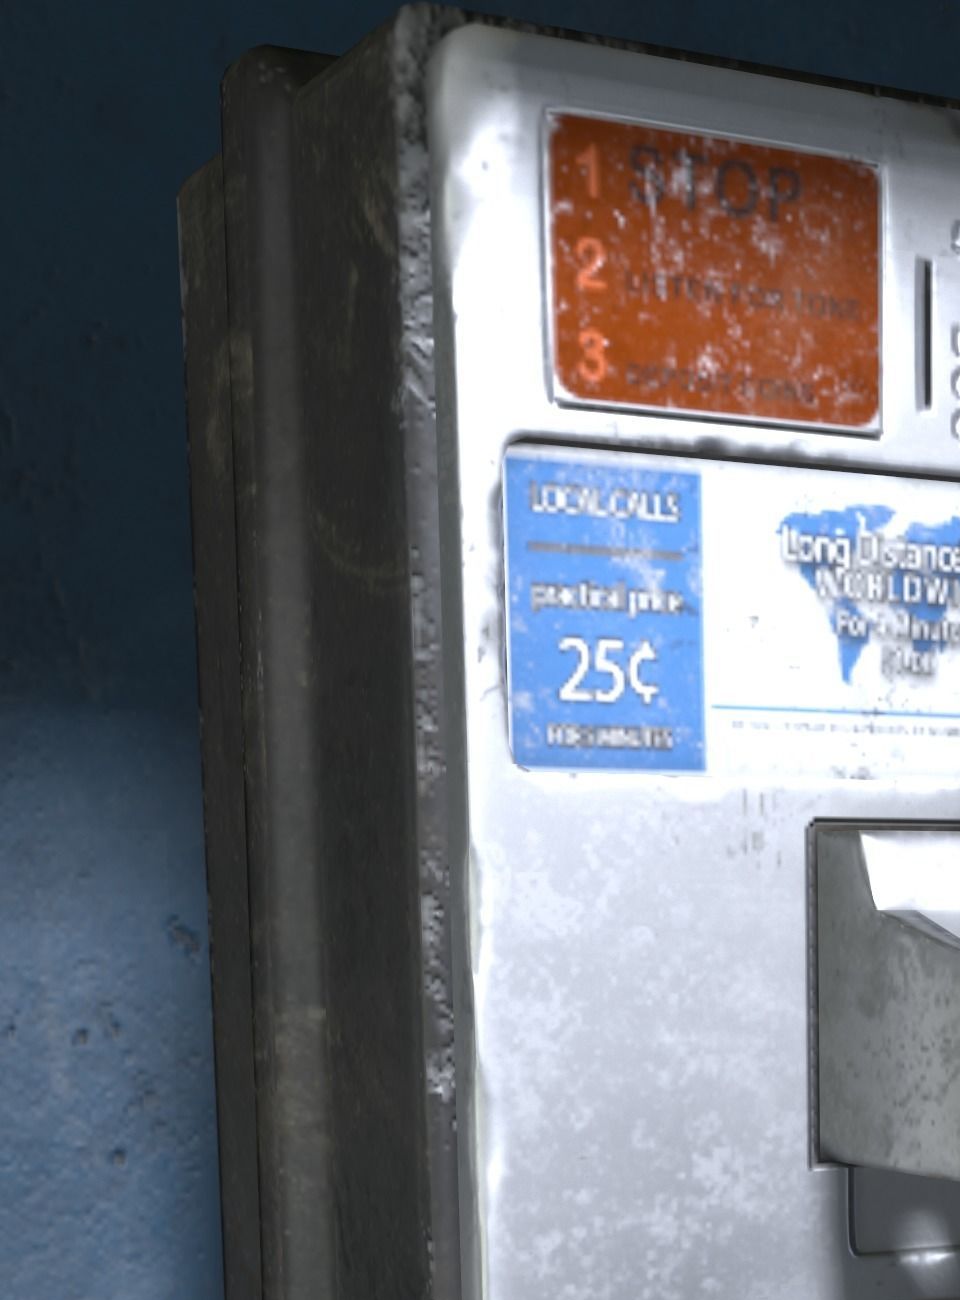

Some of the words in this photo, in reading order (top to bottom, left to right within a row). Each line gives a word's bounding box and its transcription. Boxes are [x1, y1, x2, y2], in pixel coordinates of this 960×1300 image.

[575, 144, 598, 198] 1
[627, 145, 801, 222] STOP
[576, 237, 606, 289] 2
[578, 330, 607, 382] 3
[781, 525, 851, 571] Long
[558, 636, 660, 704] 25¢
